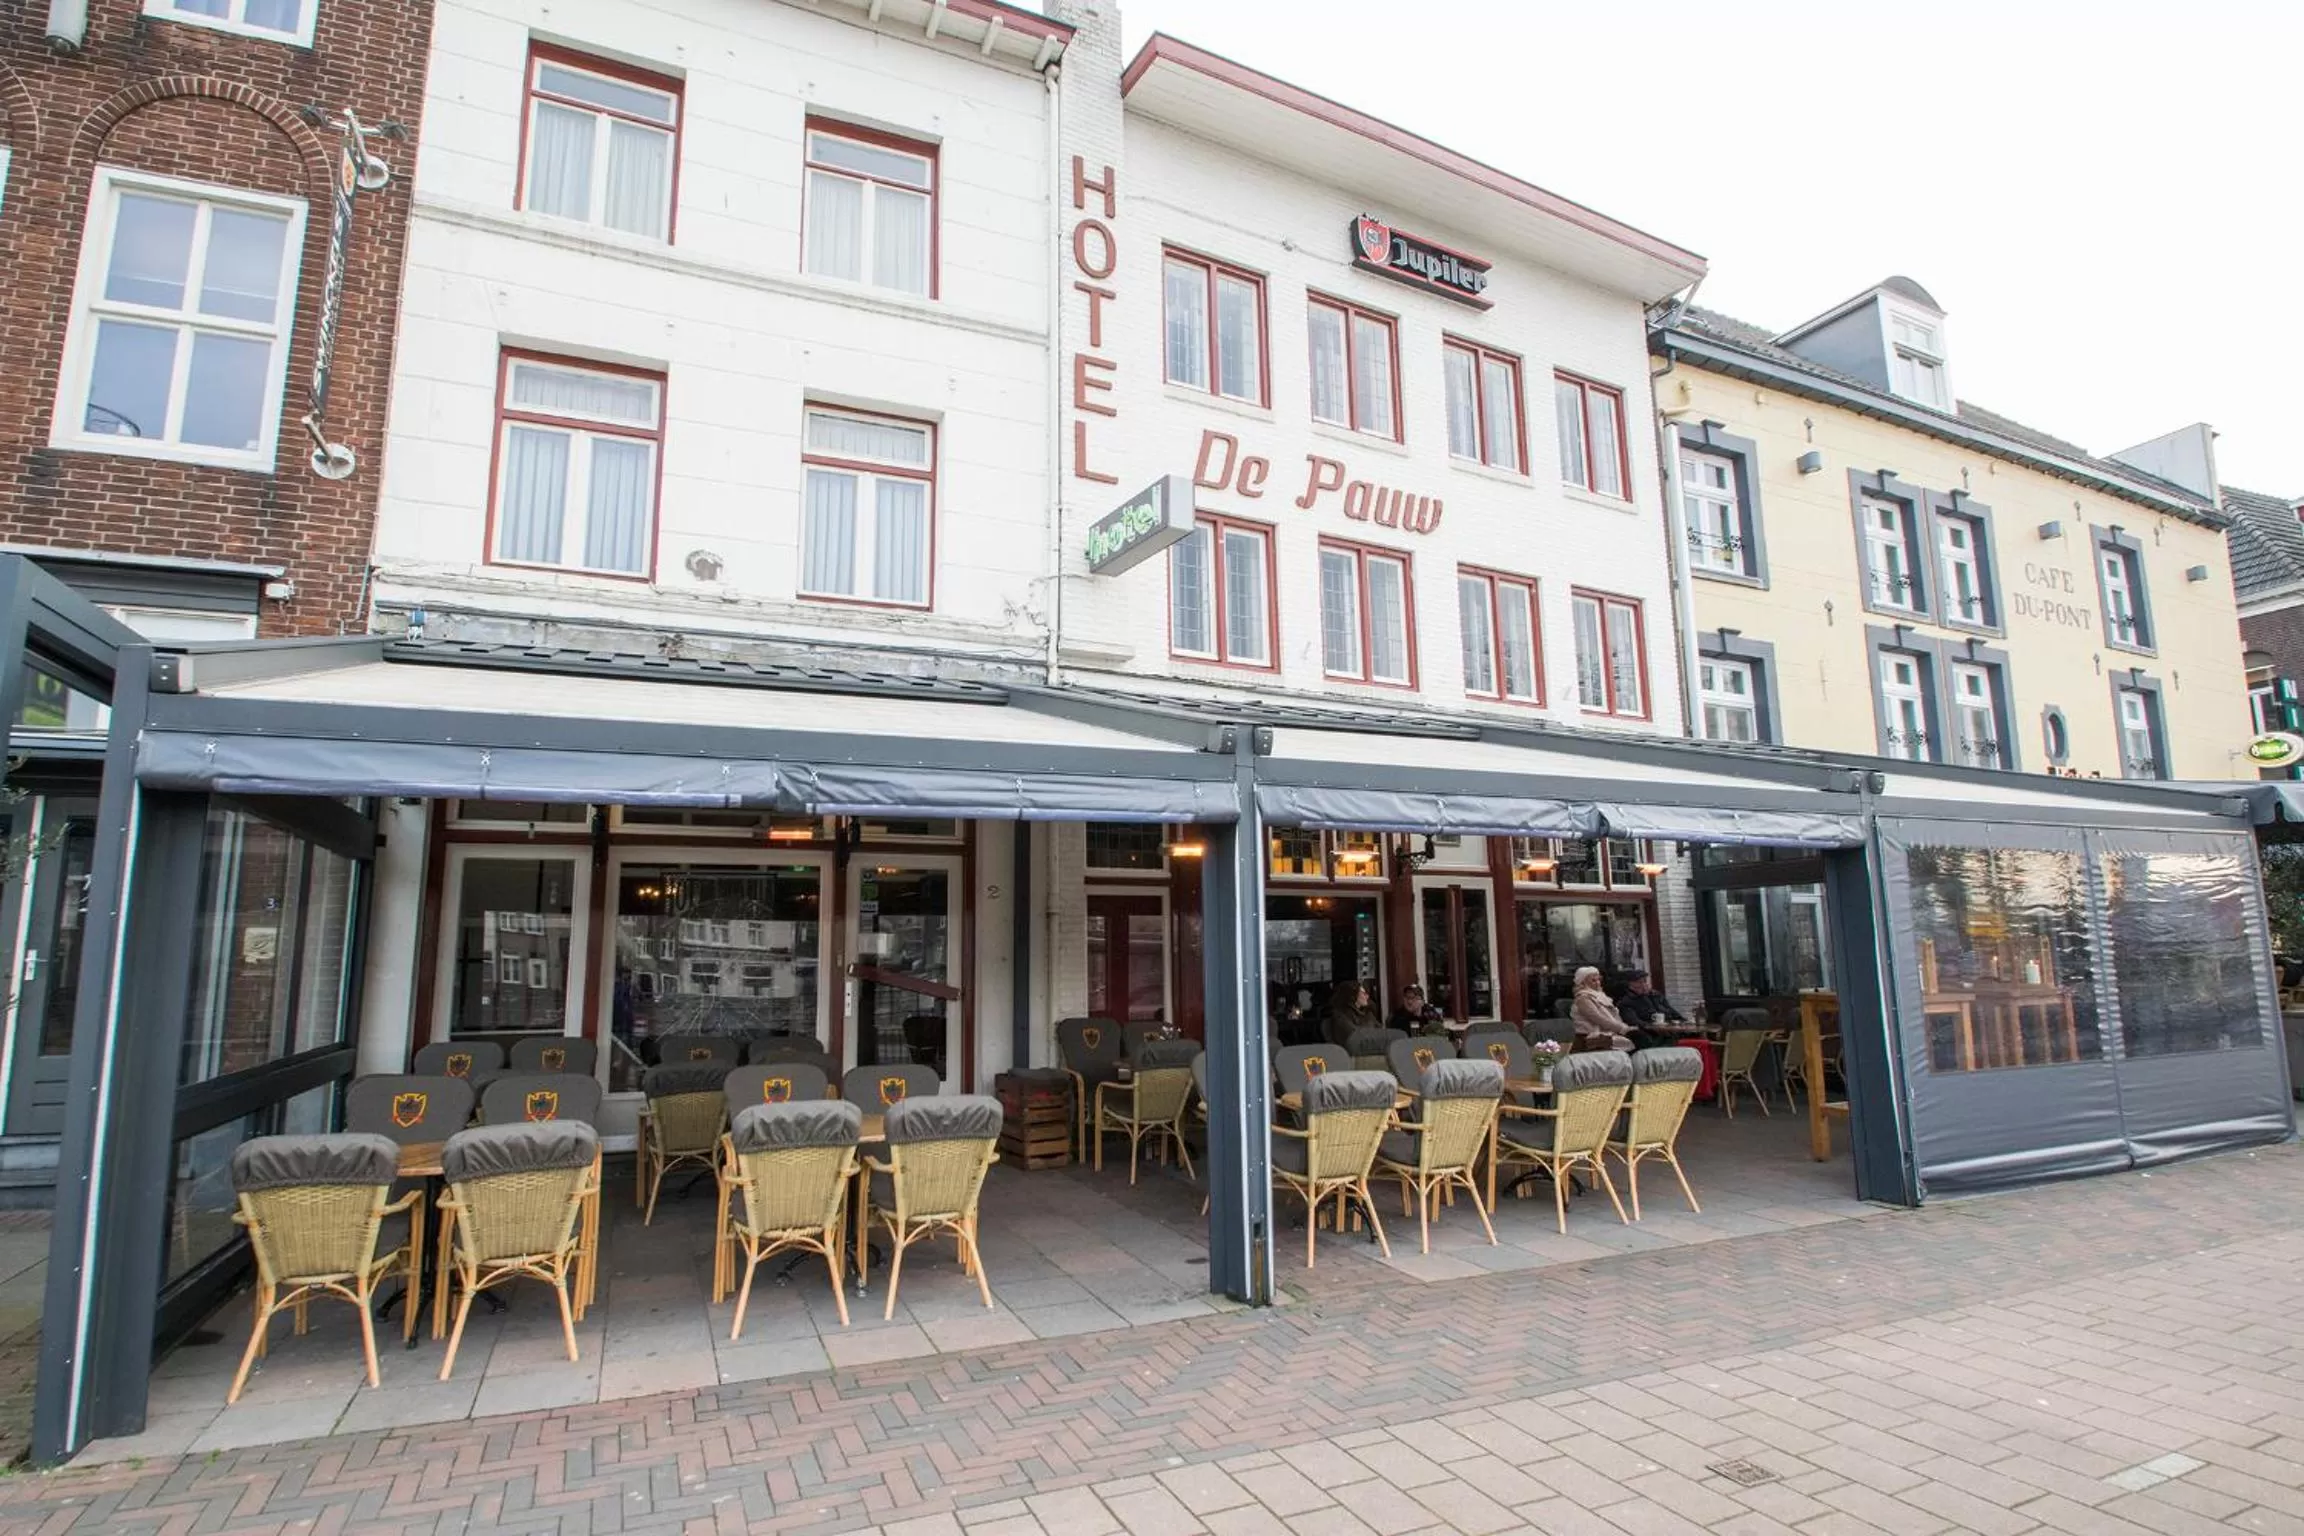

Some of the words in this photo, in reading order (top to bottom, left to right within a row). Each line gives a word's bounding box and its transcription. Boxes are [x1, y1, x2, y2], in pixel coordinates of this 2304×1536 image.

[1391, 237, 1488, 292] Jupiler
[1073, 155, 1119, 485] HOTEL
[1192, 428, 1270, 498] De
[1295, 453, 1443, 536] Pauw
[1089, 484, 1162, 565] hotel
[2024, 561, 2075, 594] CAFE
[986, 884, 1001, 899] 2
